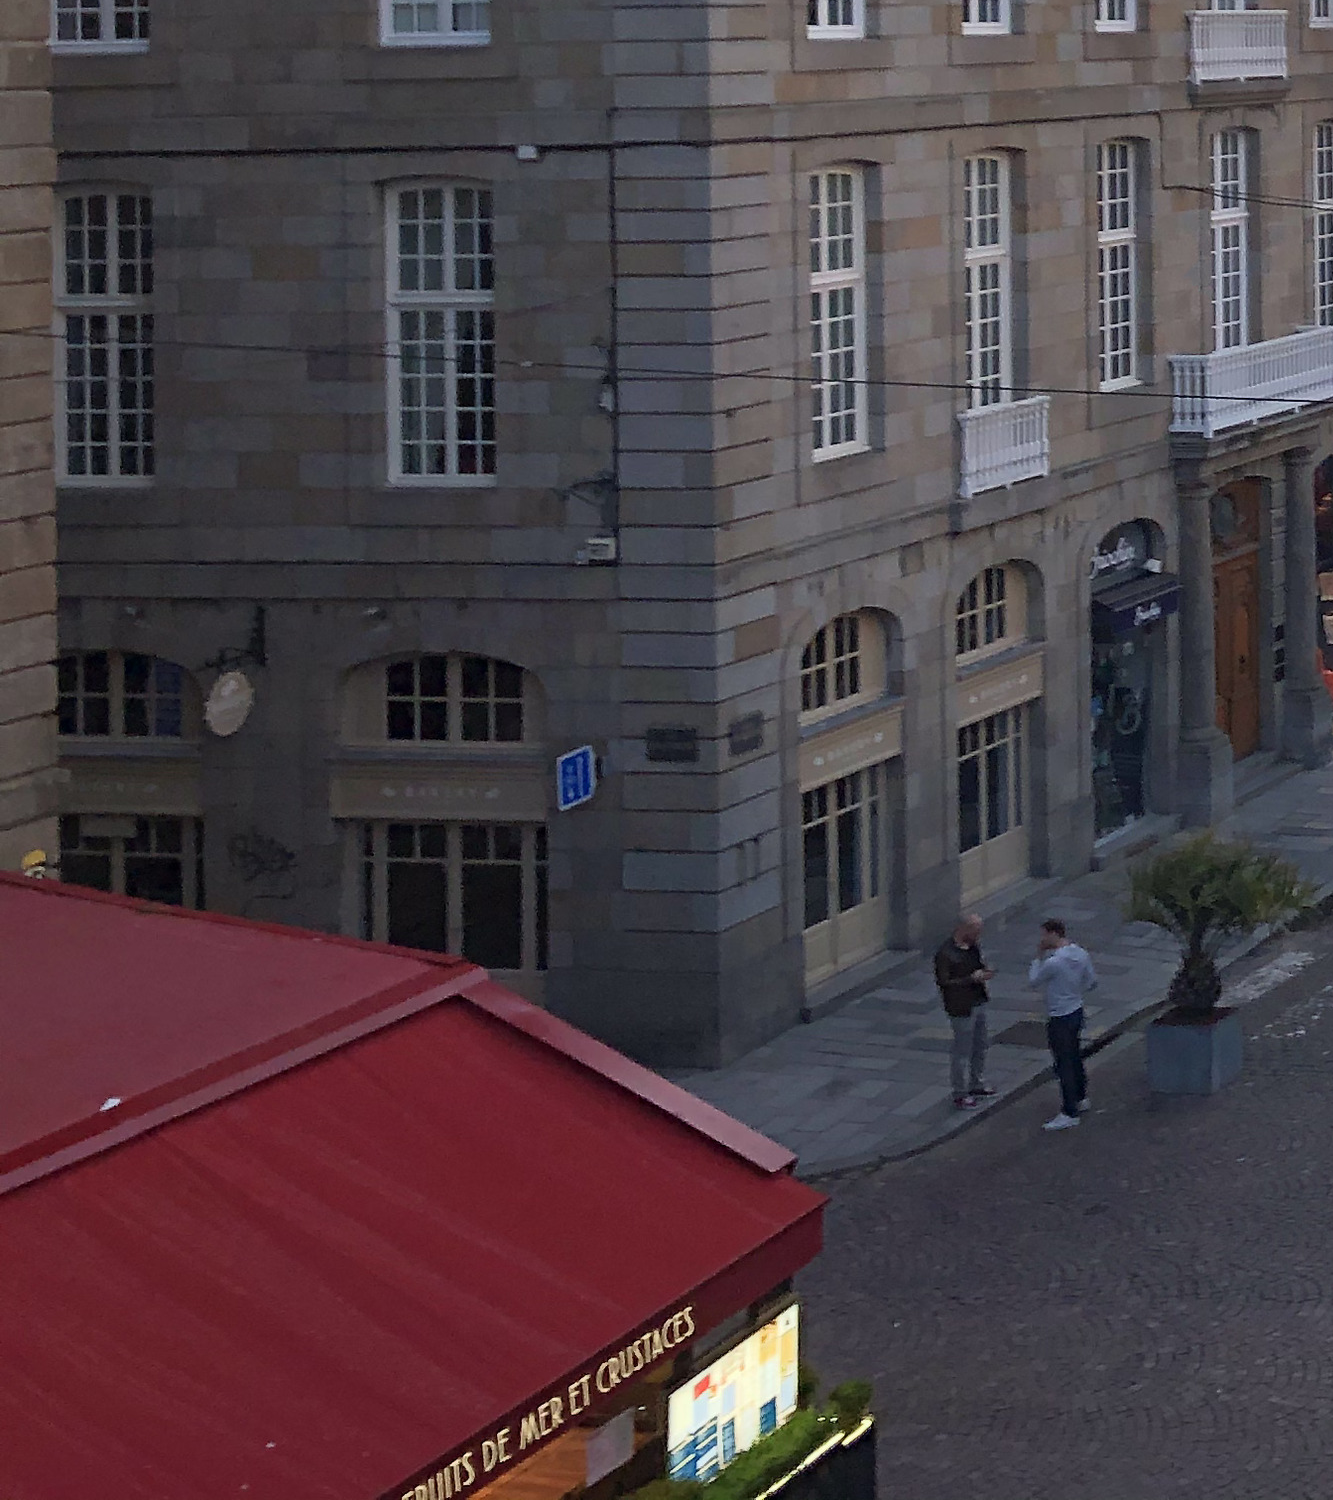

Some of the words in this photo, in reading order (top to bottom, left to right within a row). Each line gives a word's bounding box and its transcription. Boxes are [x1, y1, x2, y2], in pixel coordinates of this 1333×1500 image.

[481, 1426, 512, 1472] DE
[519, 1396, 565, 1450] MER
[568, 1373, 592, 1416] ET
